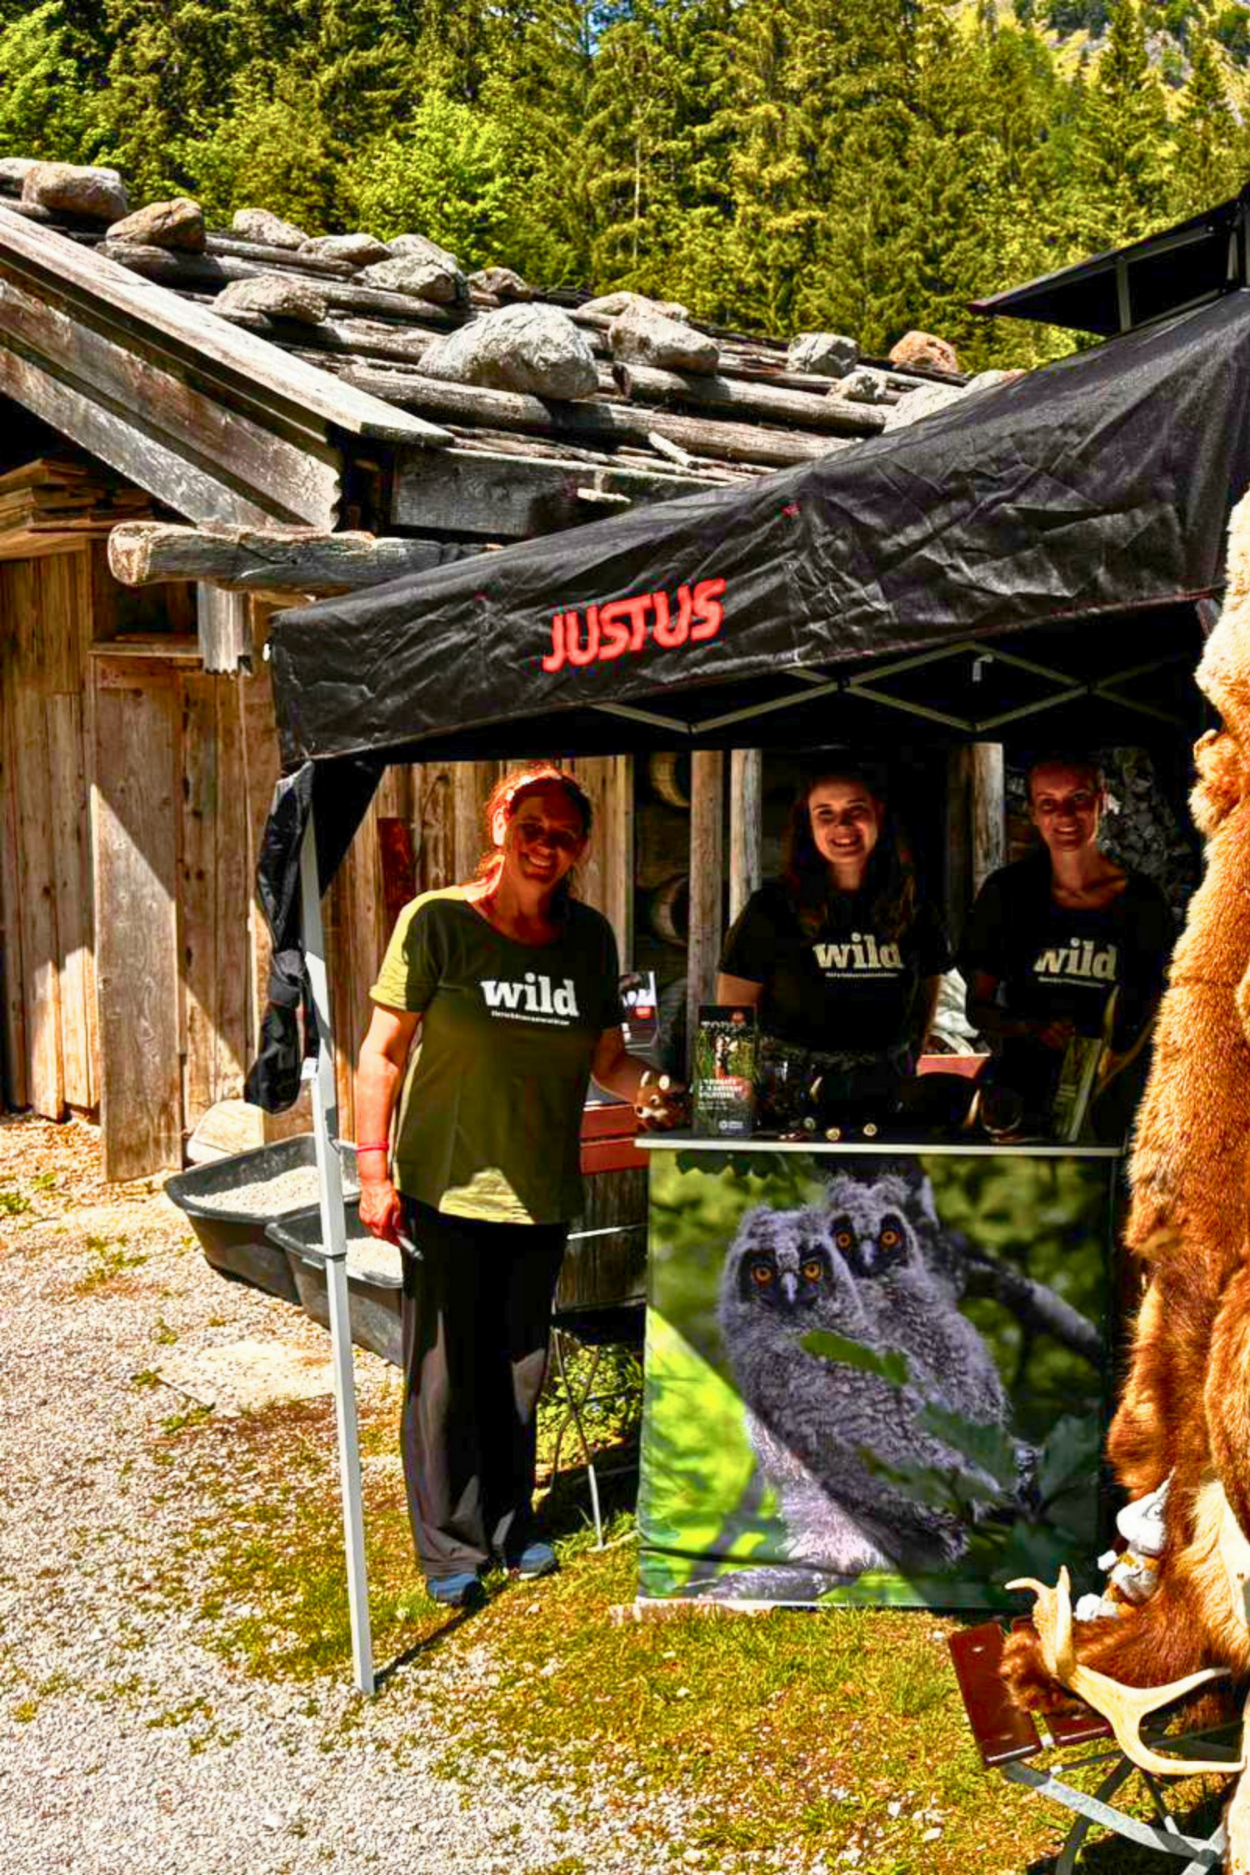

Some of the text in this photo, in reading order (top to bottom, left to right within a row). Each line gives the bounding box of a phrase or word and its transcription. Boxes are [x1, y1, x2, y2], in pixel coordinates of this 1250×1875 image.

[541, 577, 727, 673] JUSTUS
[812, 931, 906, 970] wild
[1031, 936, 1117, 982] wild
[479, 971, 580, 1017] wild
